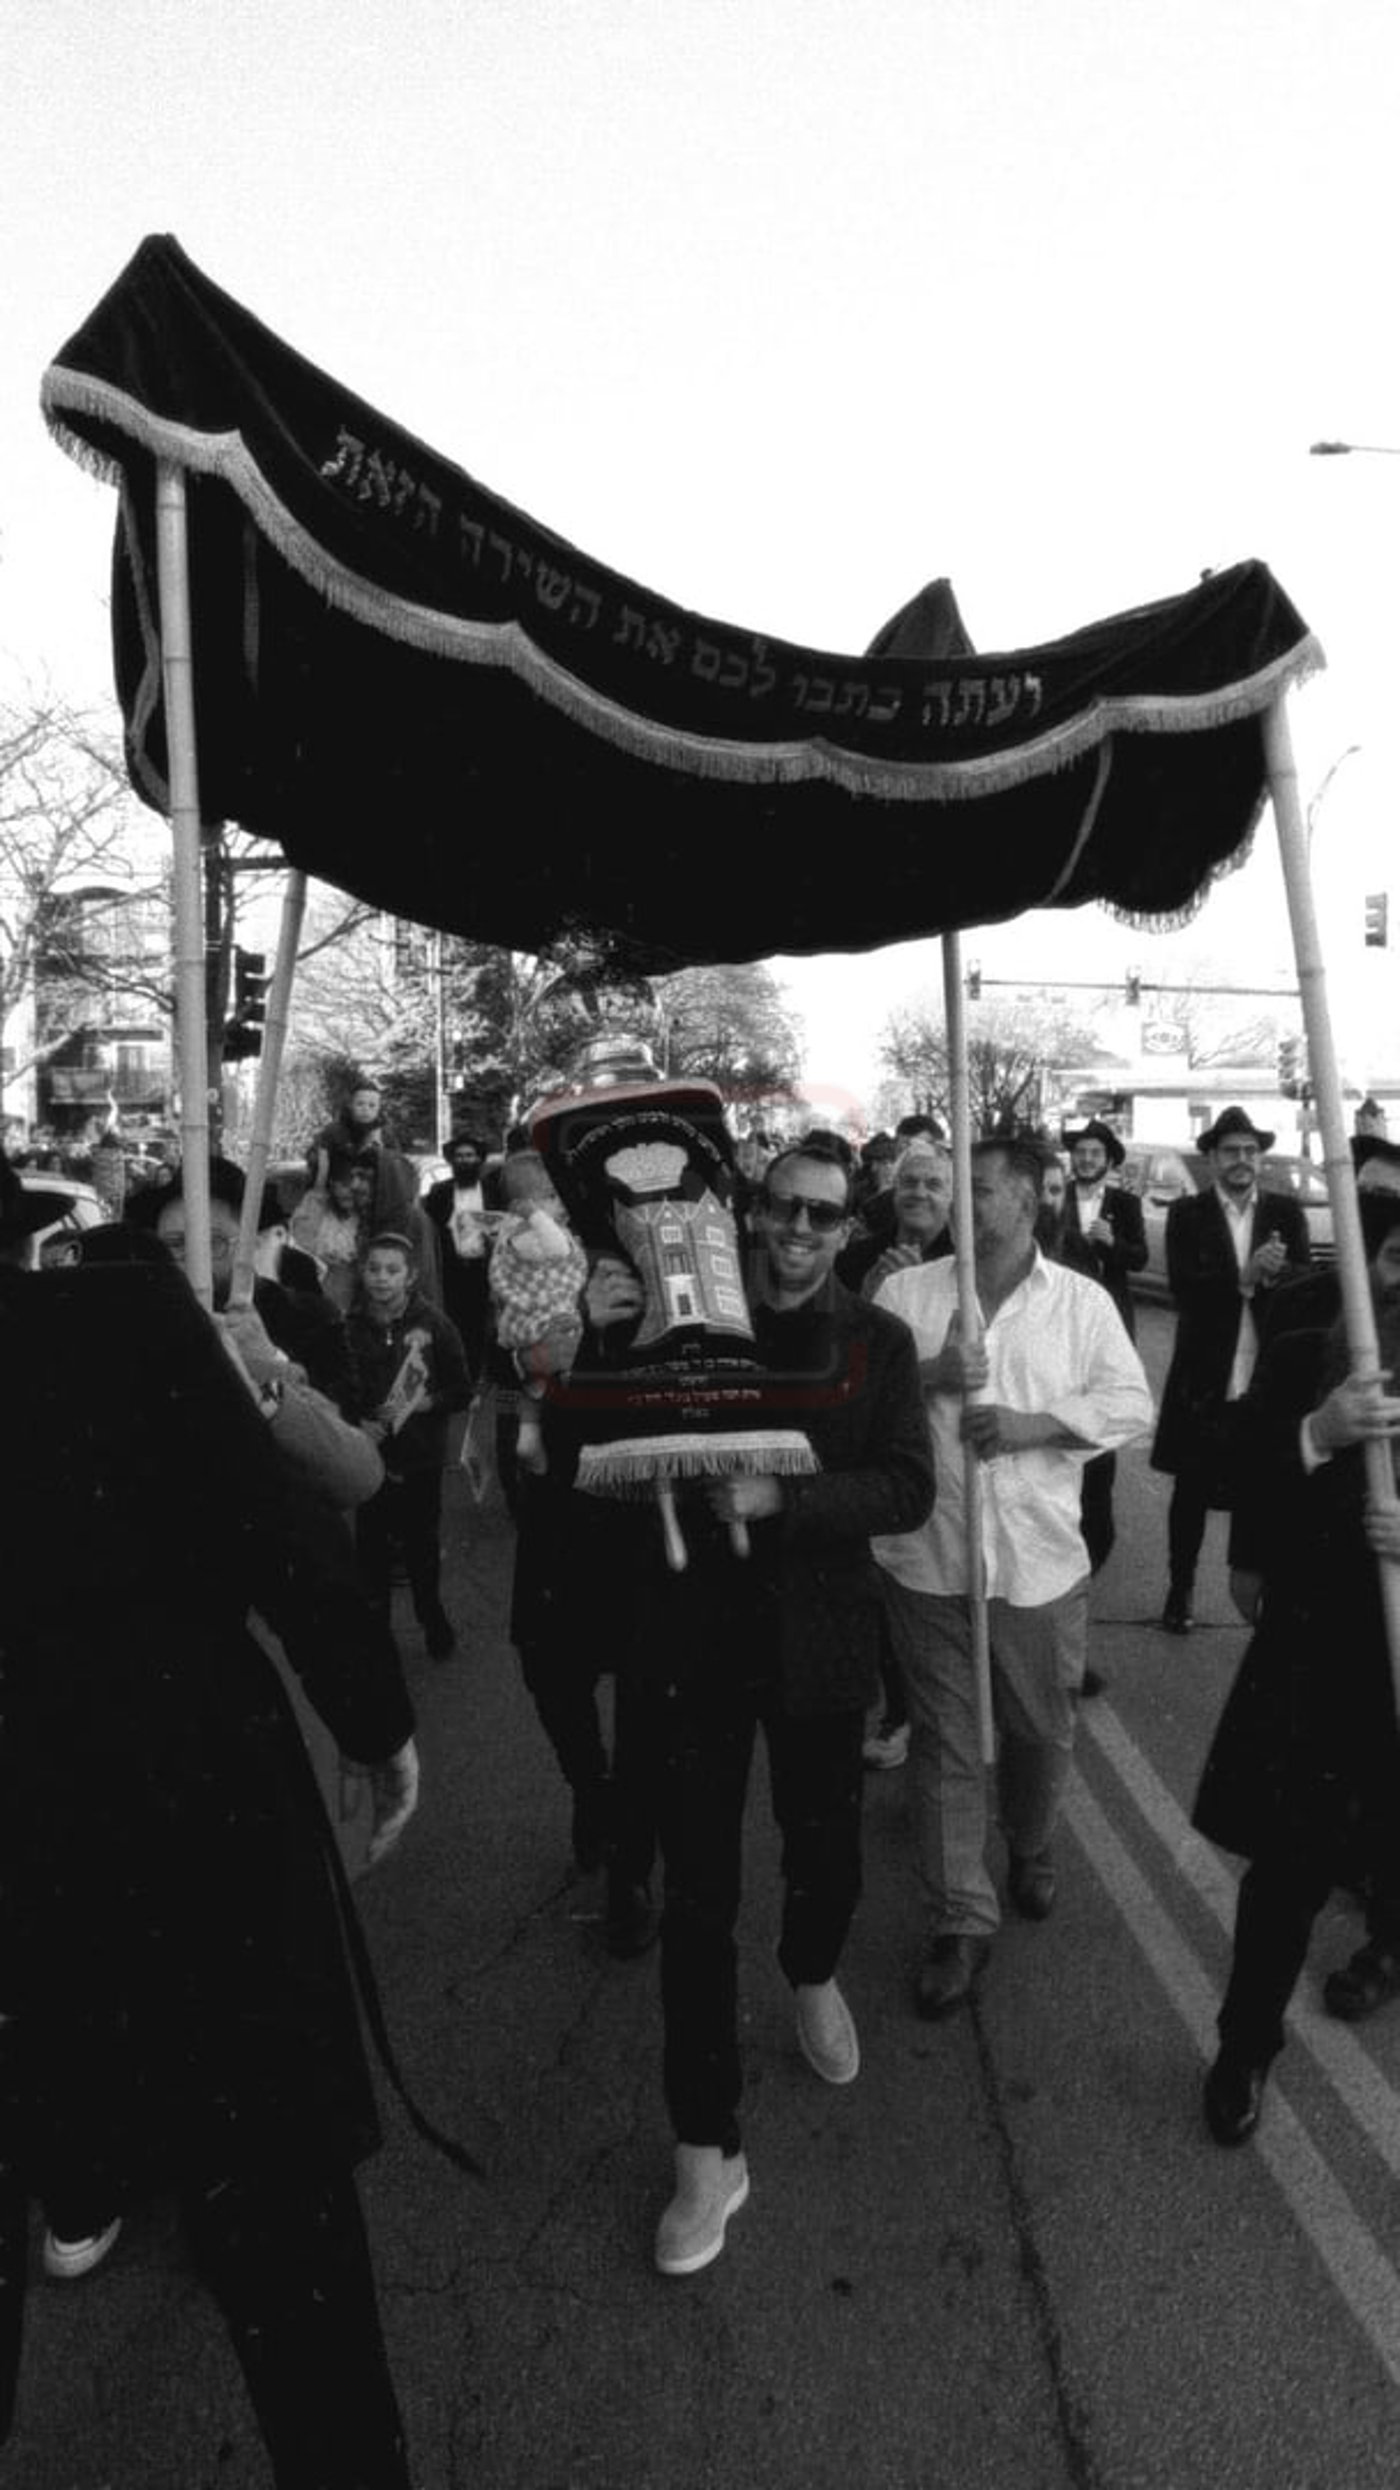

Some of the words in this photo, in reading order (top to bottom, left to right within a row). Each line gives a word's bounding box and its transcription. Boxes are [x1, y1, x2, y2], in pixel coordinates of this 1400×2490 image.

[320, 424, 442, 536] הזאת
[460, 514, 603, 629] השירה
[612, 604, 682, 665] את
[691, 637, 777, 699] לכם
[791, 673, 904, 721] כתבו
[920, 671, 1042, 727] ועתה
